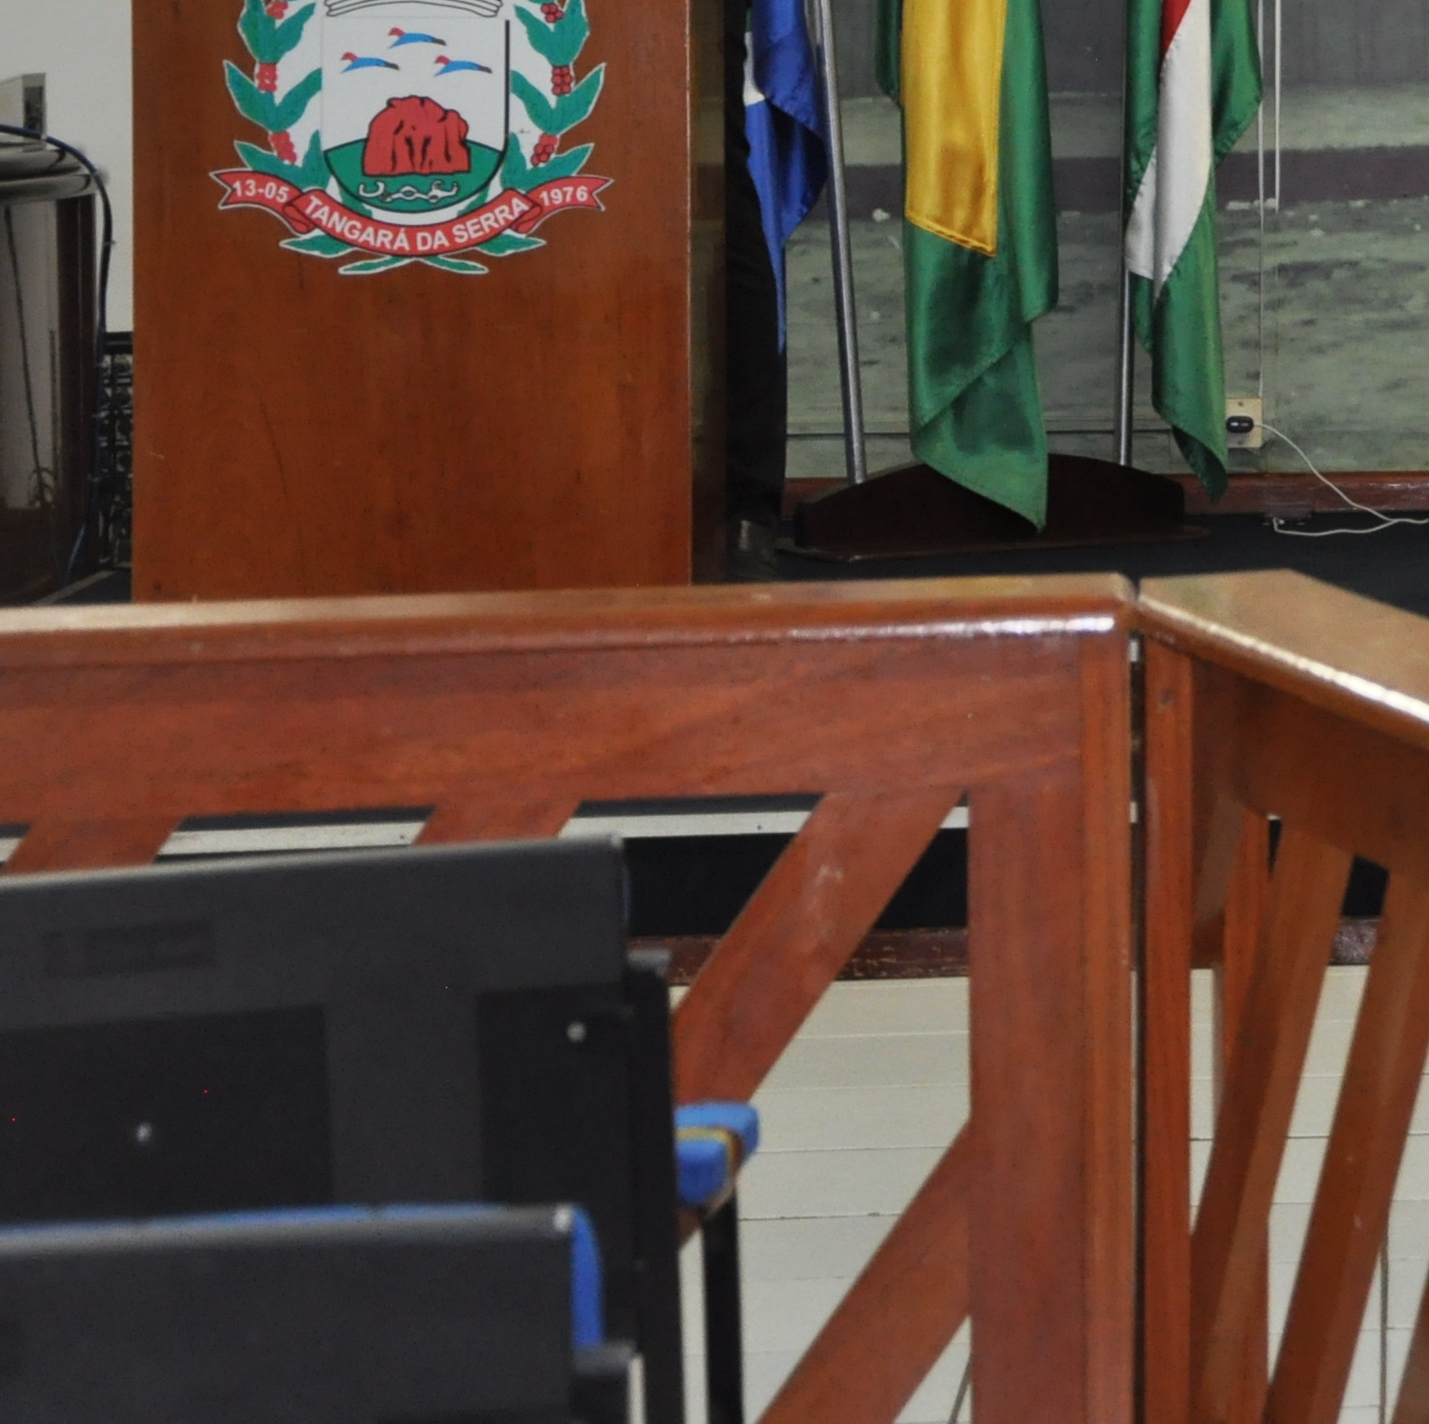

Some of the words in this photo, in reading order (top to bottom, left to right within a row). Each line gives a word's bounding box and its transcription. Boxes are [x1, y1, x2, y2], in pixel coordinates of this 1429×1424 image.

[232, 179, 290, 204] 13-05
[539, 185, 589, 207] 1976
[304, 196, 411, 253] TANGARÁ
[416, 229, 449, 252] DA
[453, 196, 530, 244] SERRA
